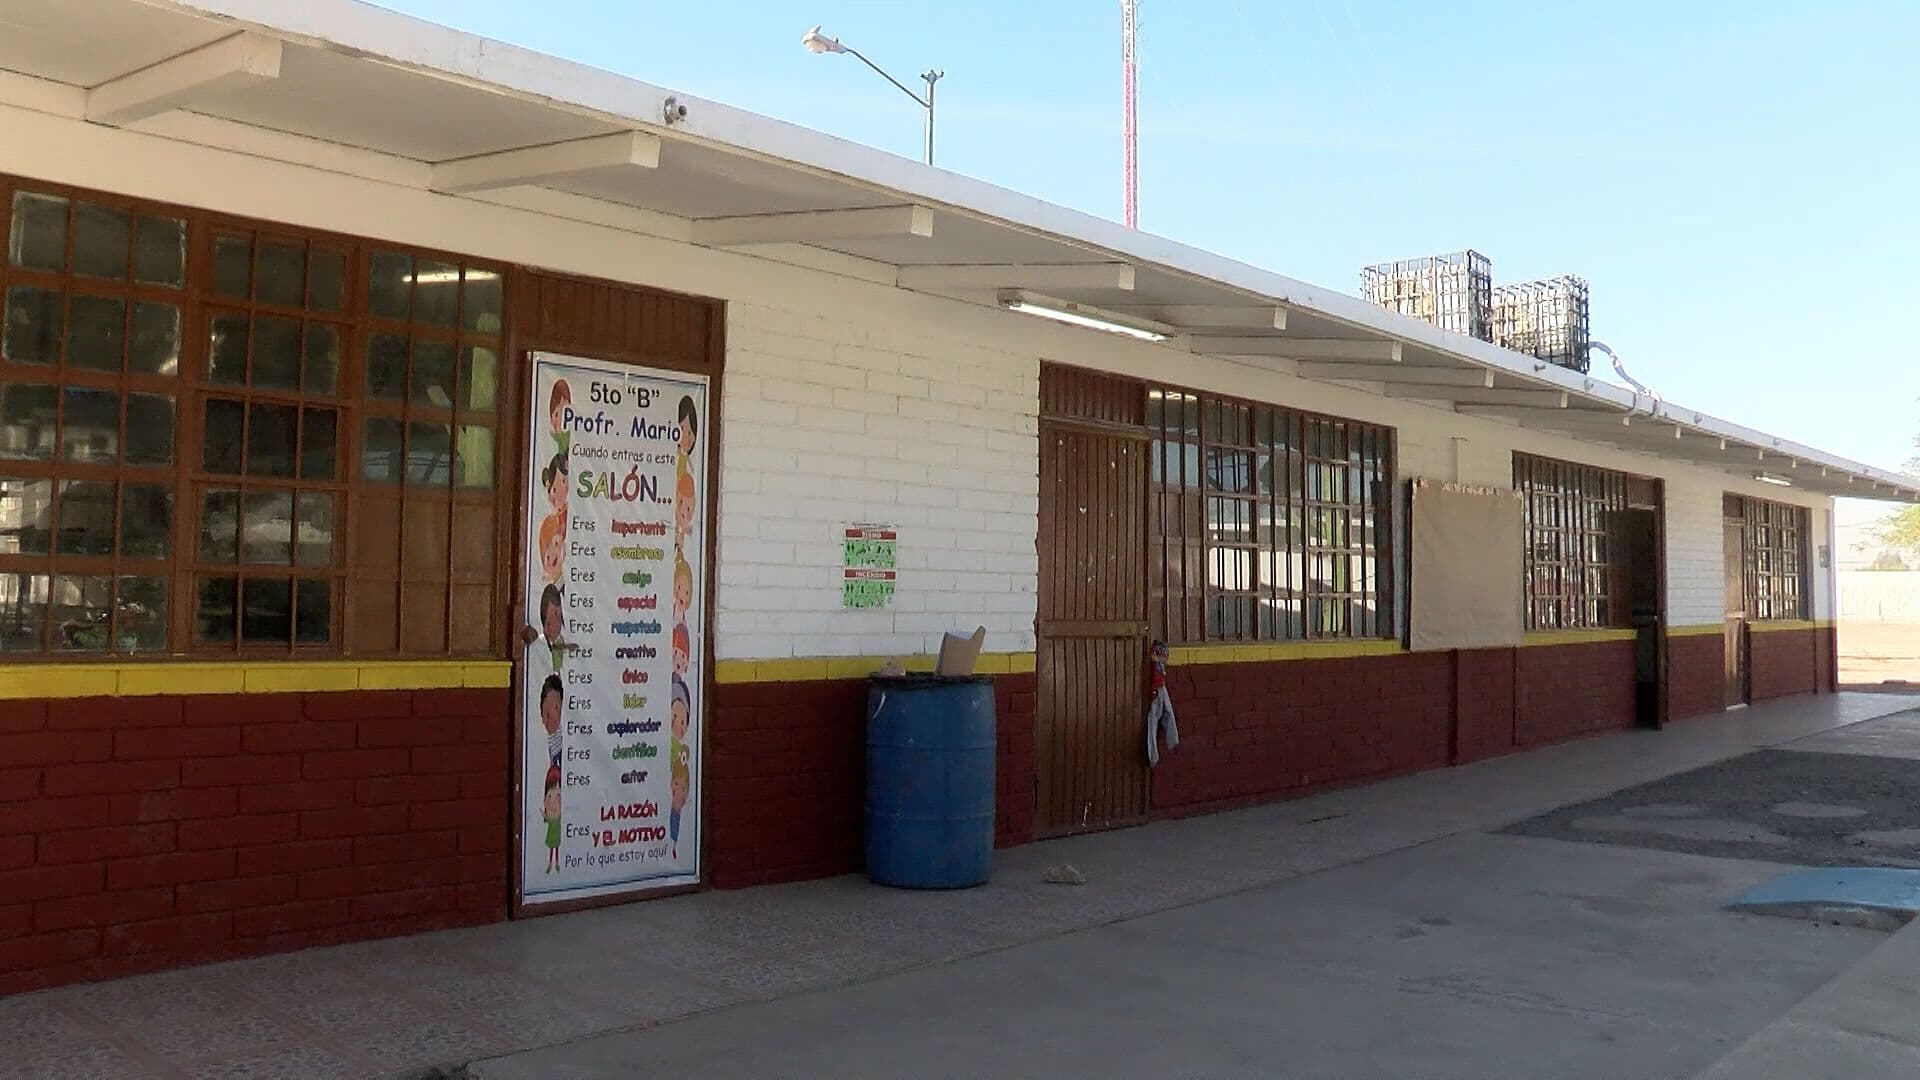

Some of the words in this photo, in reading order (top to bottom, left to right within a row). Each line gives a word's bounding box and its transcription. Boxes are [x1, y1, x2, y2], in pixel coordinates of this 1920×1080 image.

[590, 382, 622, 405] 5to
[563, 407, 620, 436] Profr.
[630, 416, 681, 442] Mario
[572, 443, 609, 459] Cuando
[611, 449, 644, 463] entras
[646, 455, 653, 464] a
[655, 454, 676, 465] este
[577, 464, 673, 505] SALÓN...
[572, 516, 596, 532] Eres
[611, 518, 666, 537] importante
[571, 541, 596, 556] Eres
[570, 567, 595, 582] Eres
[622, 569, 653, 588] amigo
[569, 593, 594, 608] Eres
[617, 593, 657, 613] especial
[569, 619, 594, 634] Eres
[611, 619, 662, 638] respetado
[568, 644, 593, 658] Eres
[615, 644, 657, 659] creativo
[568, 670, 593, 684] Eres
[568, 695, 592, 710] Eres
[566, 721, 593, 736] Eres
[606, 718, 662, 738] explorador
[567, 747, 591, 762] Eres
[566, 772, 591, 786] Eres
[621, 769, 648, 784] autor
[600, 804, 616, 822] LA
[617, 798, 659, 819] RAZÓN
[566, 823, 590, 838] Eres
[592, 831, 600, 848] Y
[602, 828, 616, 847] EL
[618, 825, 667, 845] MOTIVO
[565, 854, 583, 868] Por
[586, 852, 595, 866] lo
[598, 853, 616, 867] que
[618, 848, 645, 863] estoy
[648, 844, 669, 860] aquí
